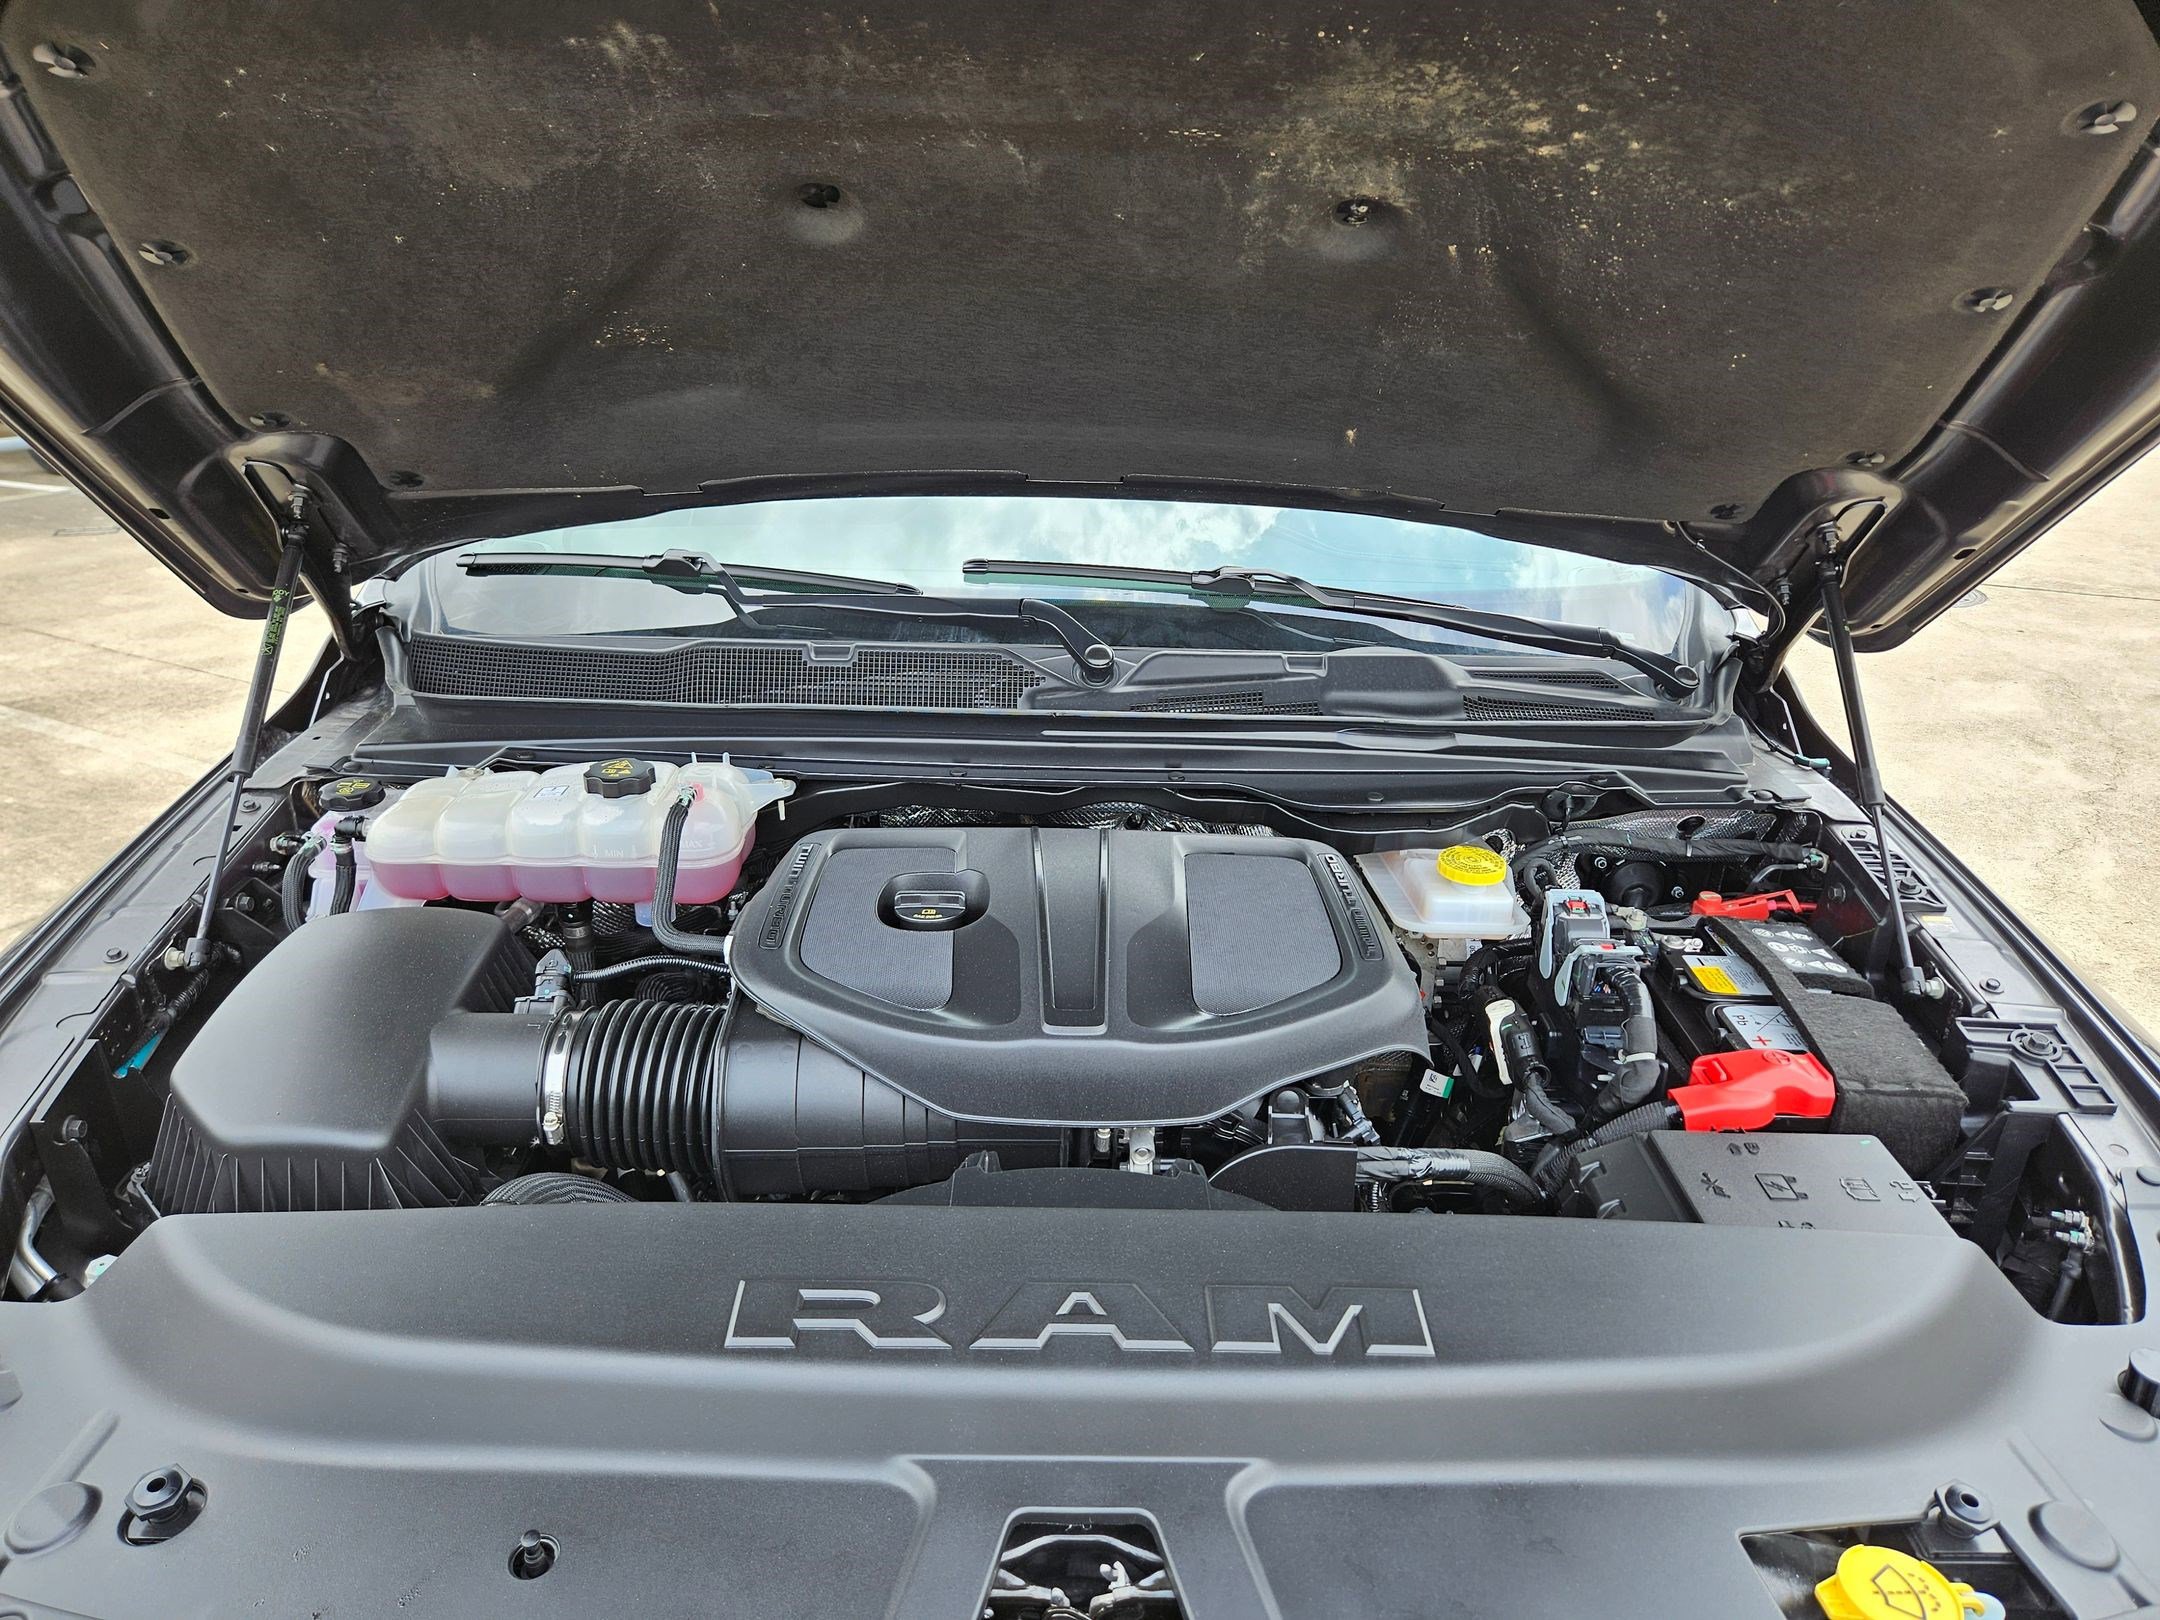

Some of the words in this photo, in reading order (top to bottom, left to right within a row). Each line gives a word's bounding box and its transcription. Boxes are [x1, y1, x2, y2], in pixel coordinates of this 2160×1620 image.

[605, 848, 624, 857] MIN
[1325, 853, 1357, 905] TURBO
[766, 881, 798, 945] TURBO
[723, 1279, 1436, 1358] RAM
